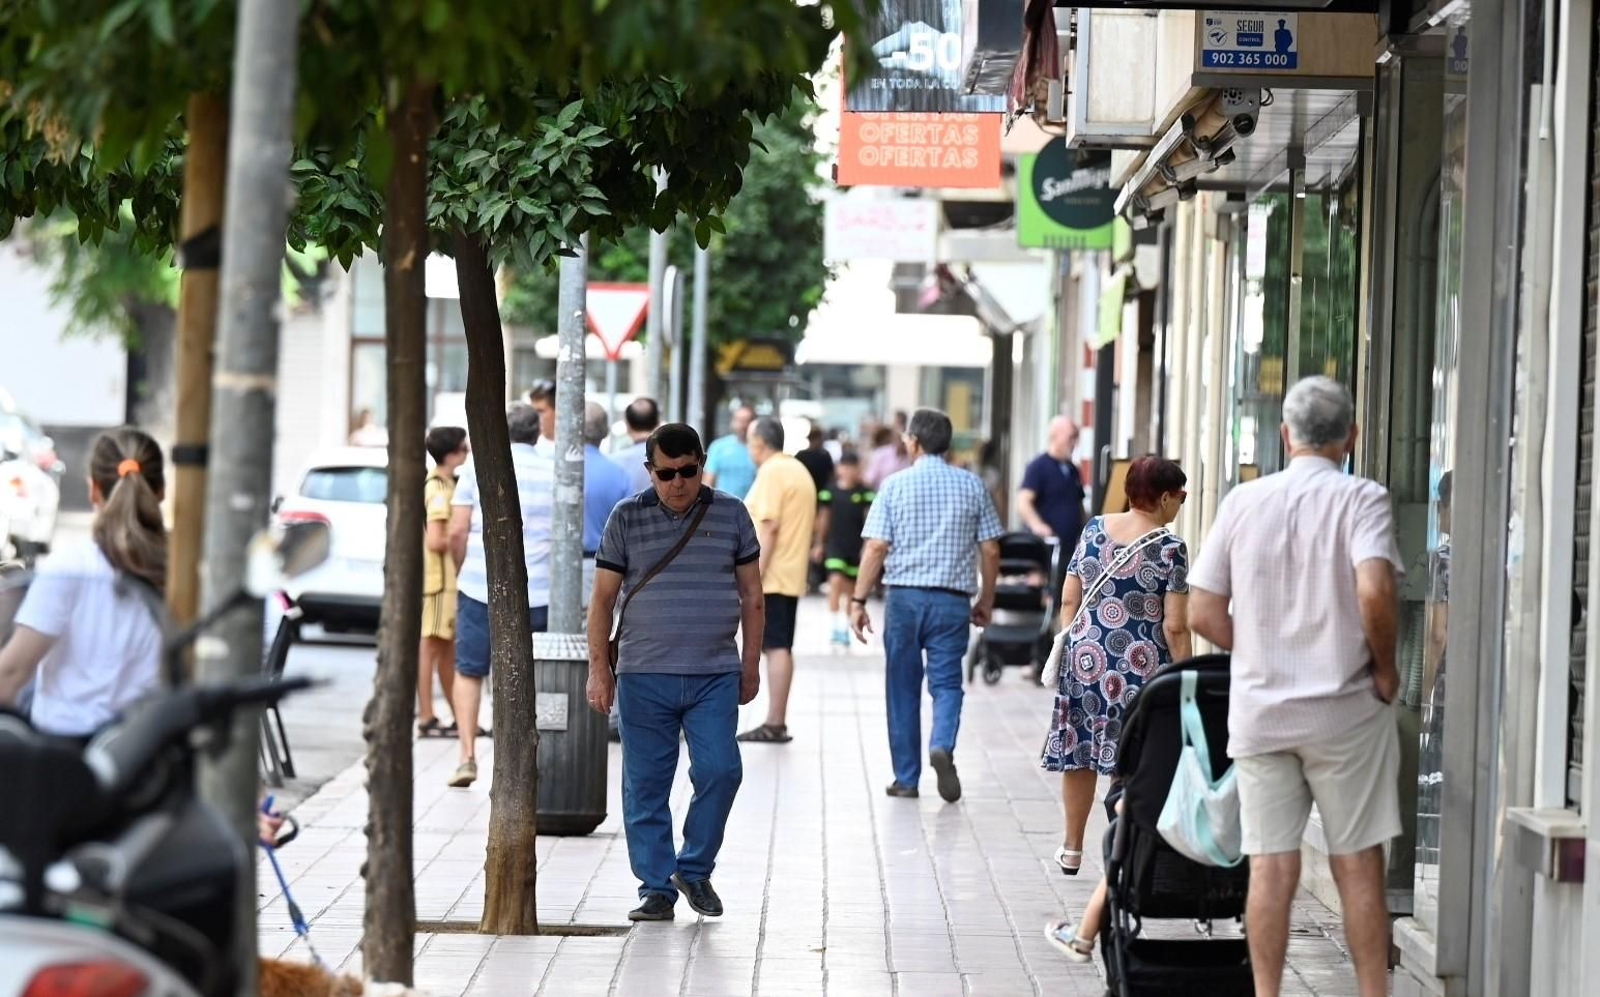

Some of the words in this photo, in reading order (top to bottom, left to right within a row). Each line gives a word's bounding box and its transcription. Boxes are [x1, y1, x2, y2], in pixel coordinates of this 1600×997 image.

[1237, 20, 1264, 32] SEGUR
[1212, 53, 1234, 64] 902
[1238, 54, 1260, 65] 365
[1265, 55, 1287, 65] 000
[859, 122, 979, 145] OFERTAS
[858, 145, 979, 168] OFERTAS
